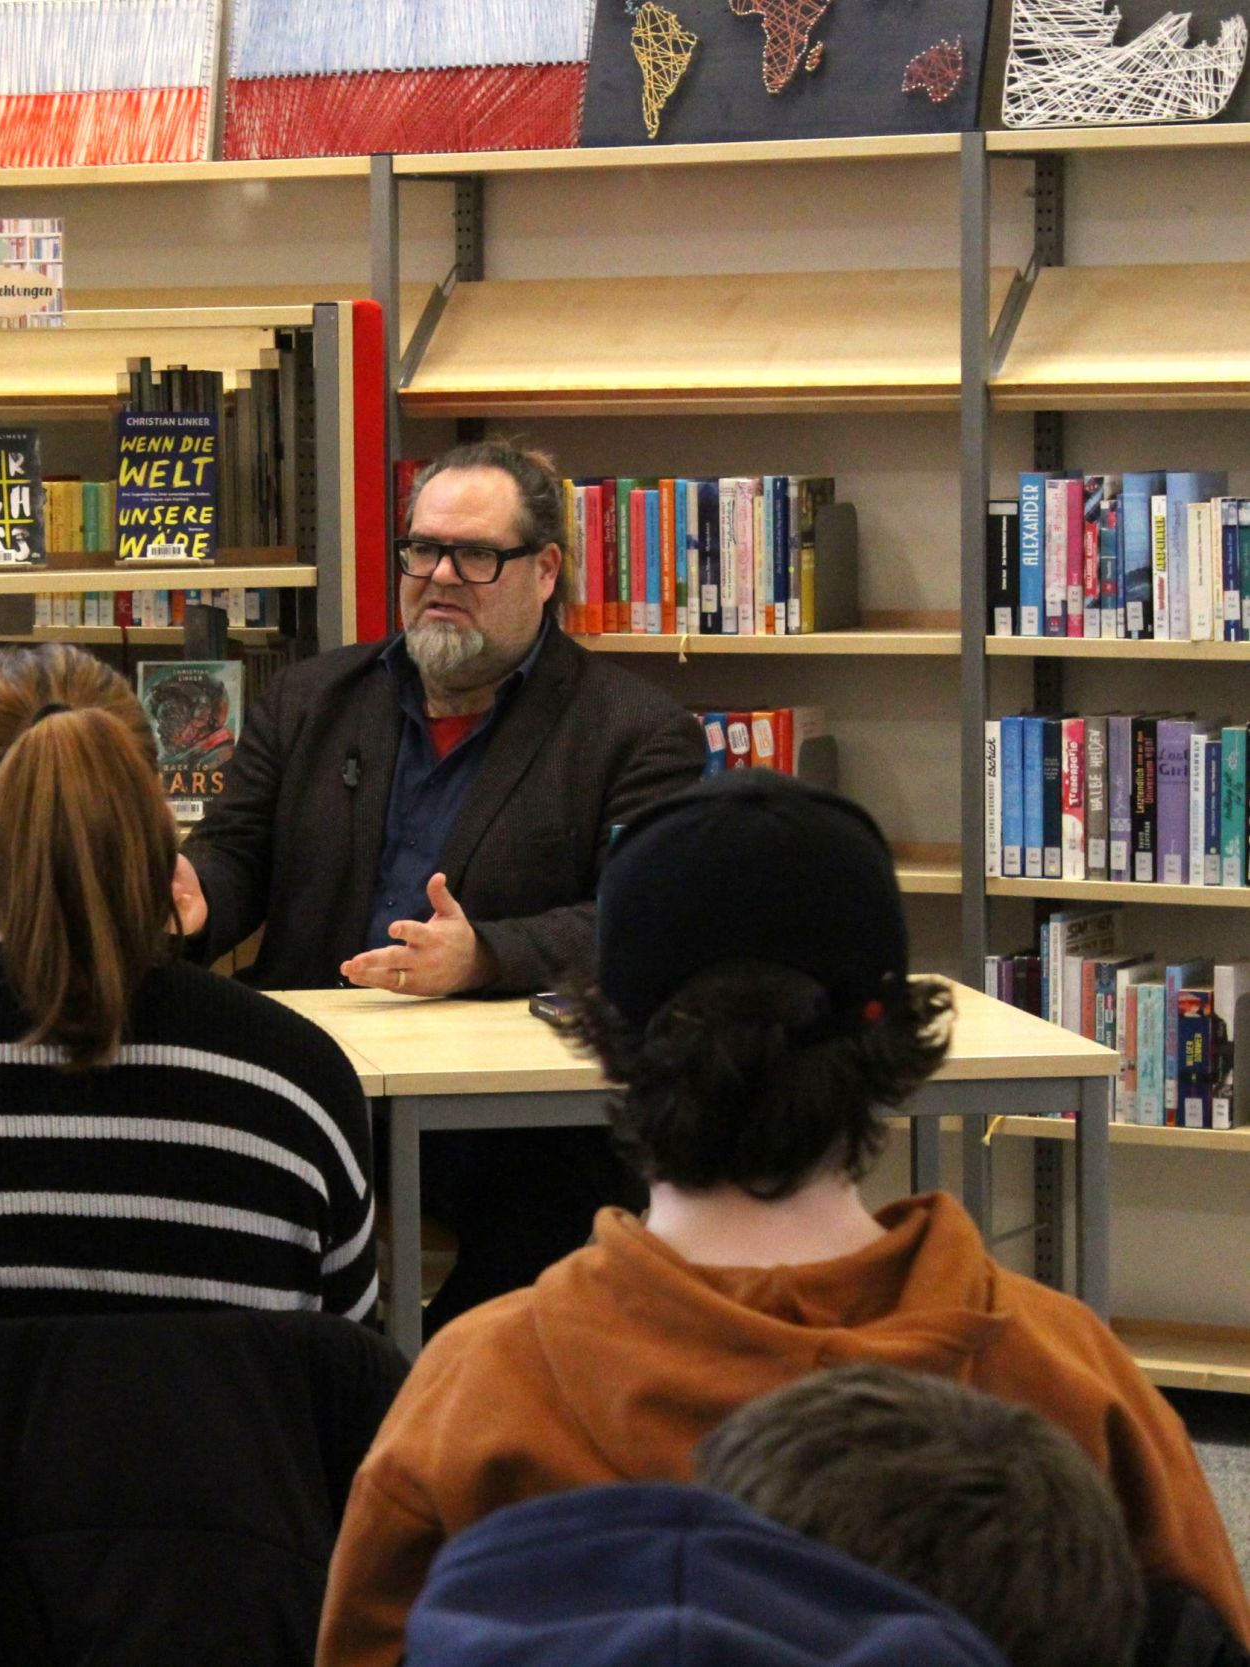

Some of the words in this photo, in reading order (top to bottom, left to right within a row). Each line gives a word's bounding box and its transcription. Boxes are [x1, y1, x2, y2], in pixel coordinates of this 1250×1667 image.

[126, 417, 176, 426] CHRISTIAN
[177, 417, 210, 426] LINKER
[120, 435, 174, 453] WENN
[179, 434, 215, 453] DIE
[118, 456, 215, 488] WELT
[118, 505, 215, 526] UNSERE
[1022, 484, 1039, 566] ALEXANDER
[986, 737, 997, 778] tschick
[1087, 728, 1103, 768] HELDEN
[159, 771, 224, 794] ARS
[1088, 773, 1103, 812] HALBE
[1135, 767, 1144, 814] Letztendlich
[1144, 760, 1154, 804] Universum
